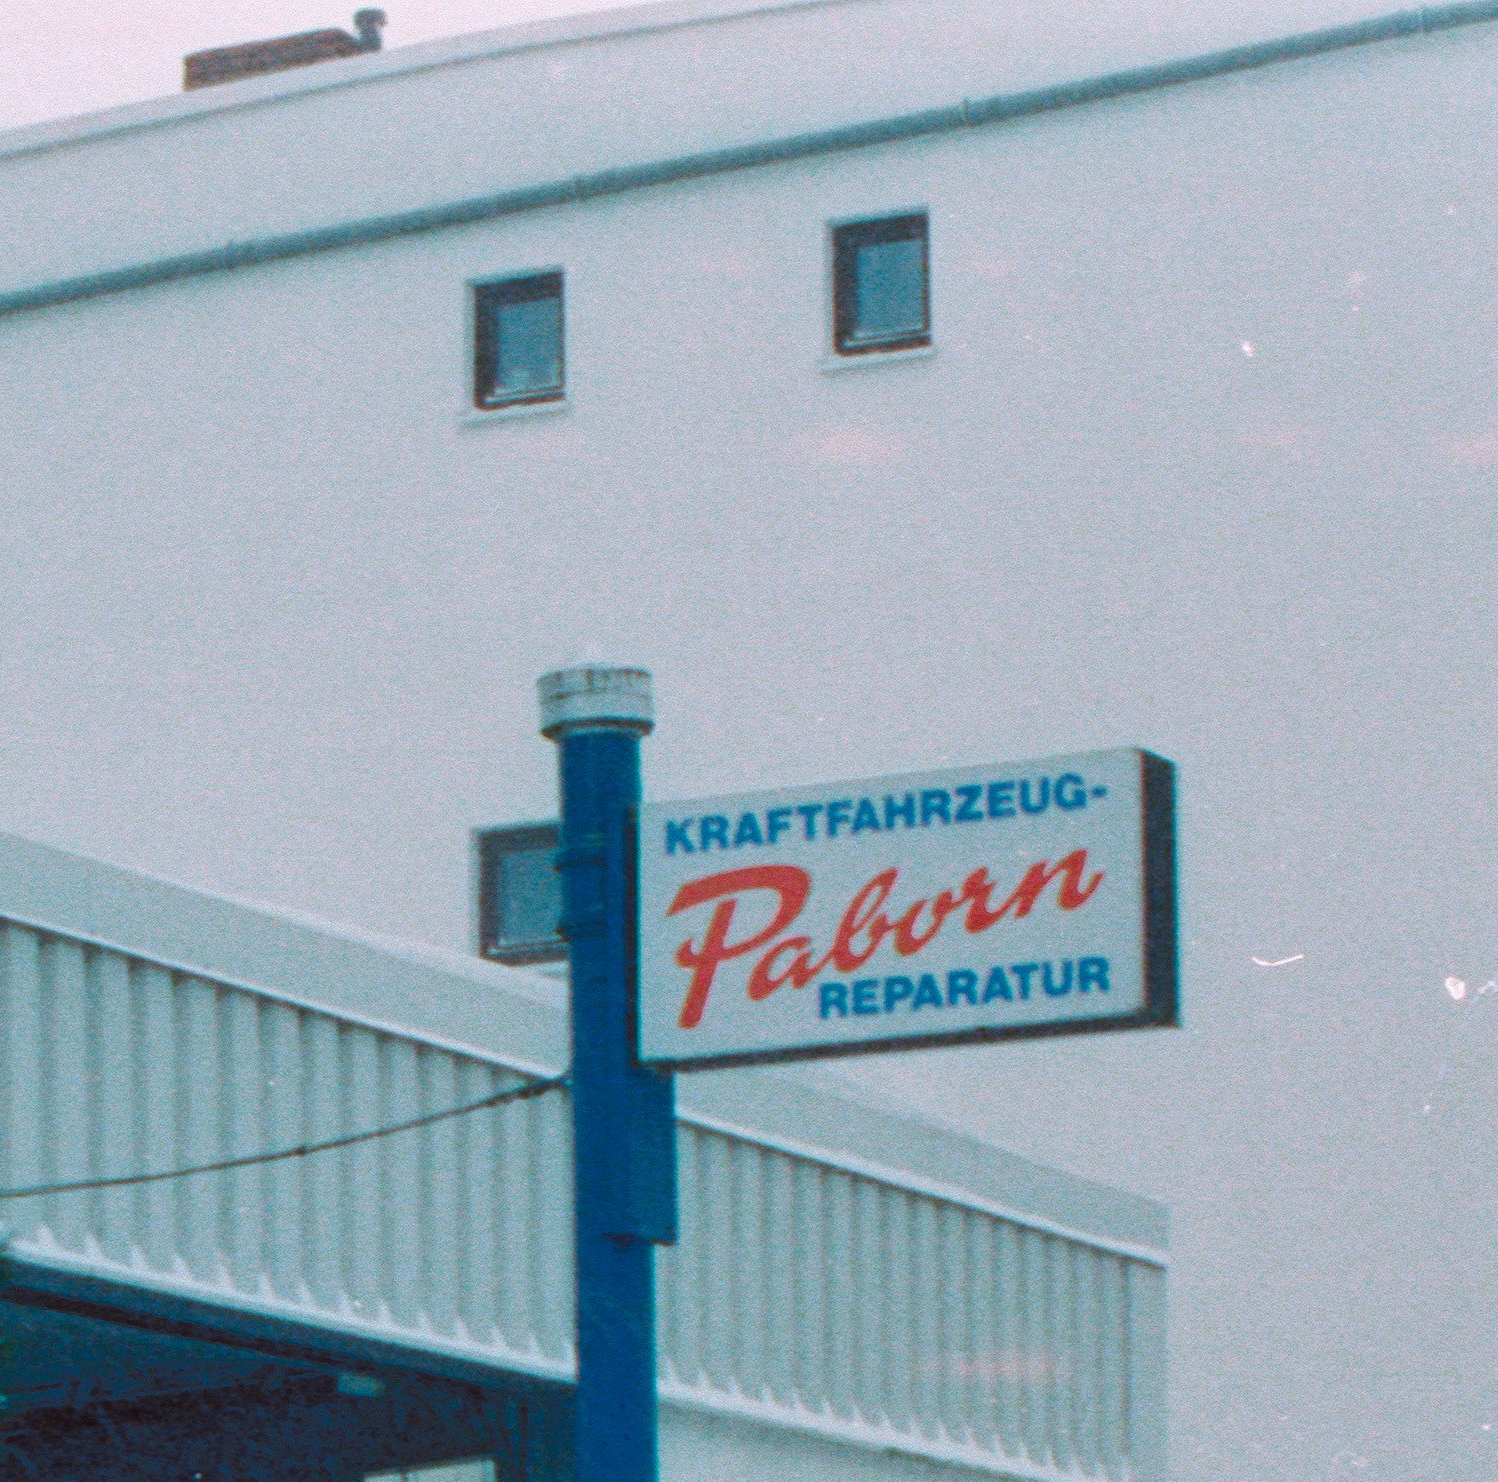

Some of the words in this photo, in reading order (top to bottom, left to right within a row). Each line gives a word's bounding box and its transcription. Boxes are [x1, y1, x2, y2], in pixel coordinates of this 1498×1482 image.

[665, 772, 1107, 855] KRAFTFAHRZEUG-
[665, 849, 1105, 1030] Paborn
[818, 955, 1109, 1020] REPARATUR
